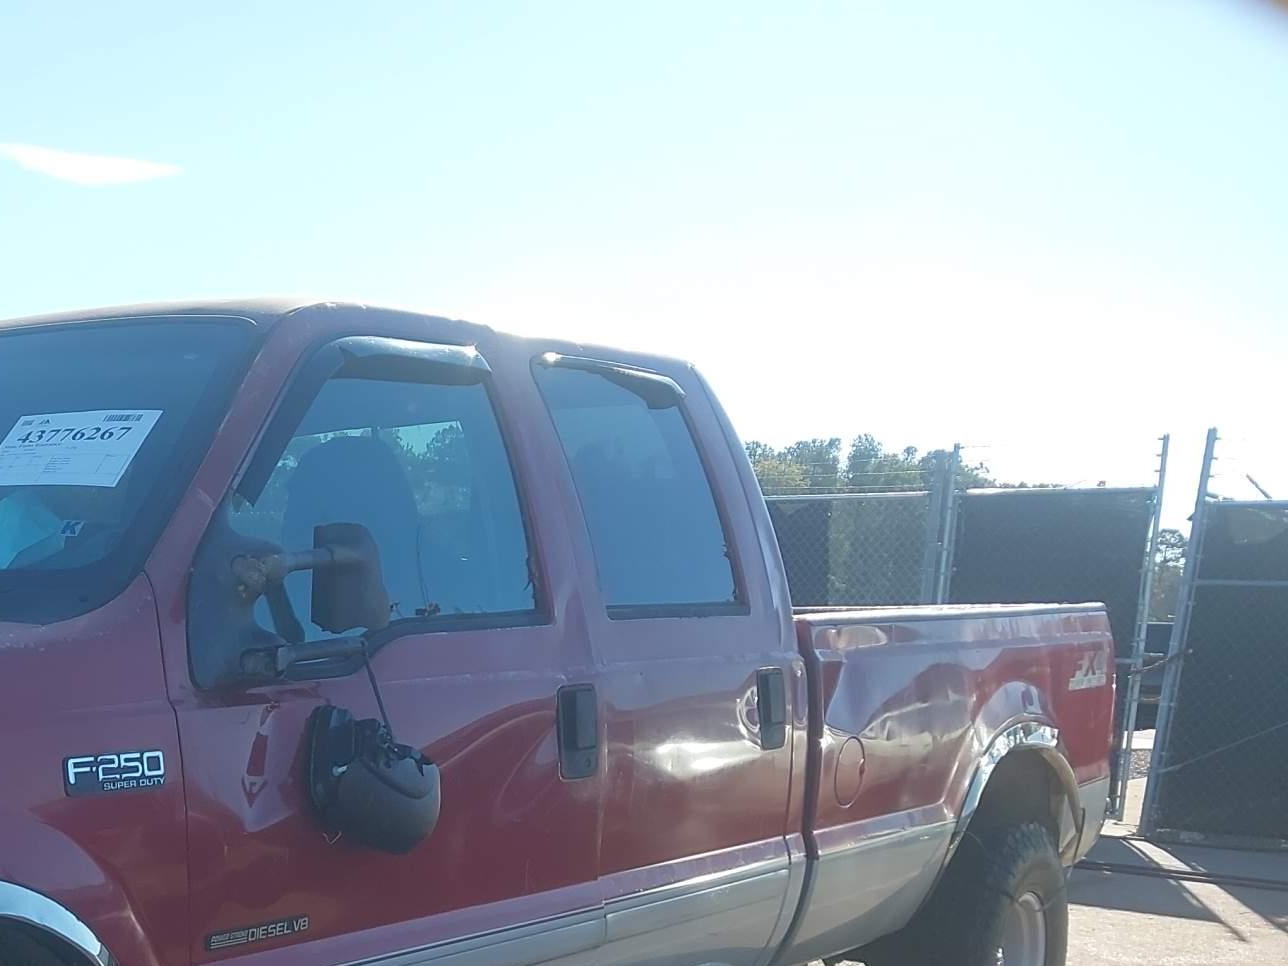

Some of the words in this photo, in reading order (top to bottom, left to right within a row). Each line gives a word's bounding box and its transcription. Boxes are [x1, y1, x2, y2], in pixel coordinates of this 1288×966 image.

[17, 426, 132, 444] 43776267
[103, 780, 137, 791] SUPER
[139, 777, 166, 787] DUTY
[248, 921, 292, 942] DIESEL
[292, 917, 309, 932] V8
